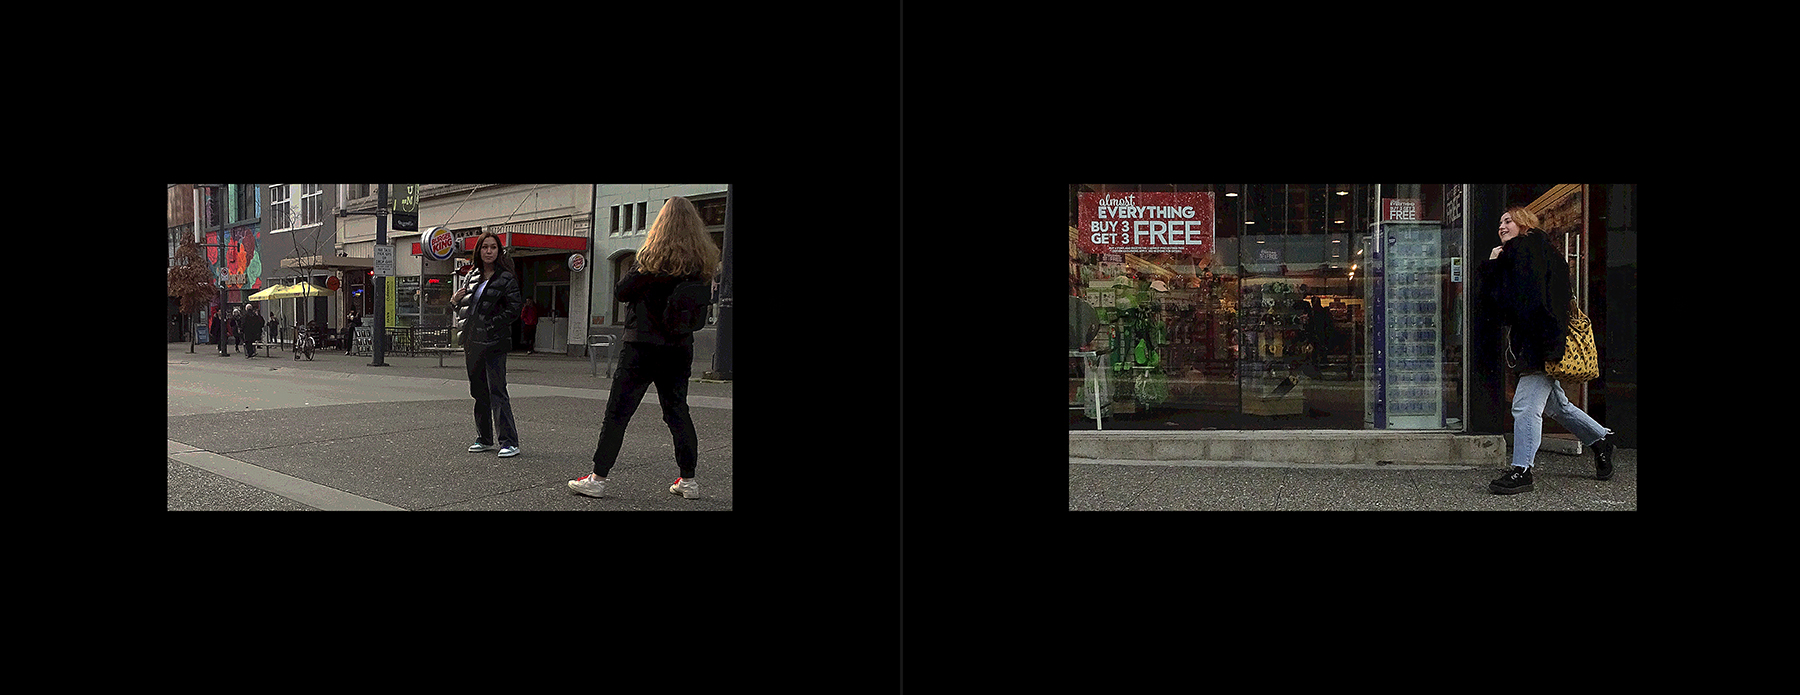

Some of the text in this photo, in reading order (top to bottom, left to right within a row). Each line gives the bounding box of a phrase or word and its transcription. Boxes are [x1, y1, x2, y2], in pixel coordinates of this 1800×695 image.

[1099, 193, 1135, 207] almost
[1098, 205, 1196, 219] EVERYTHING
[1390, 210, 1415, 220] FREE
[1091, 221, 1130, 232] BUY 3
[1133, 220, 1202, 245] FREE
[431, 232, 451, 246] BURGER
[432, 239, 453, 253] KING
[1091, 233, 1130, 245] GET 3
